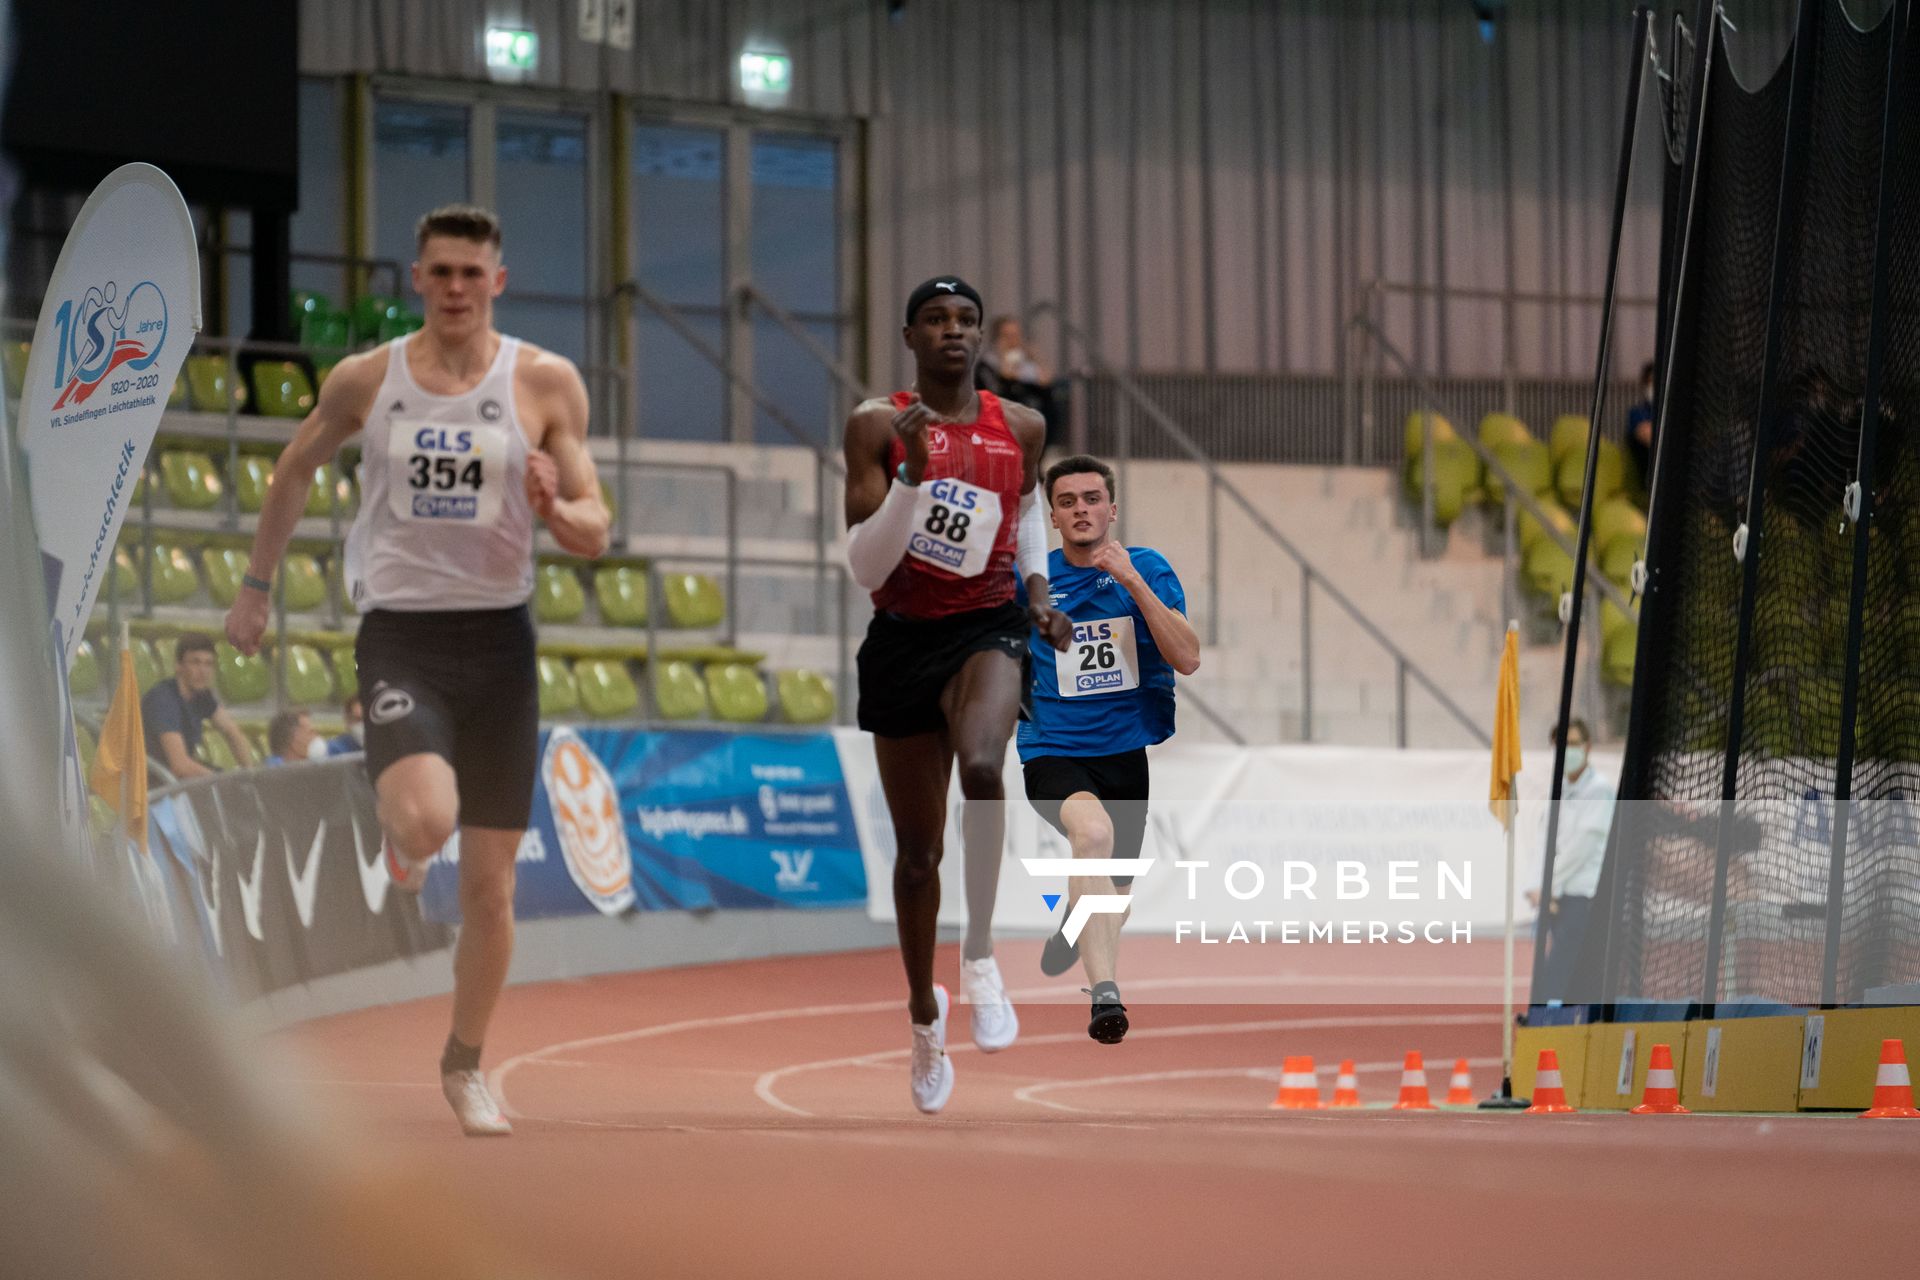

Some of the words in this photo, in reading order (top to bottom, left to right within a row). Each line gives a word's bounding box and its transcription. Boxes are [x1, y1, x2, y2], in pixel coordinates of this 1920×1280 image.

[135, 317, 164, 334] Jahre
[63, 407, 107, 426] Sindelfingen
[108, 394, 156, 414] Leichtathletik
[408, 455, 484, 491] 354
[925, 504, 971, 543] 88
[932, 543, 963, 561] PLAN
[1078, 642, 1115, 671] 26
[1095, 673, 1121, 684] PLAN
